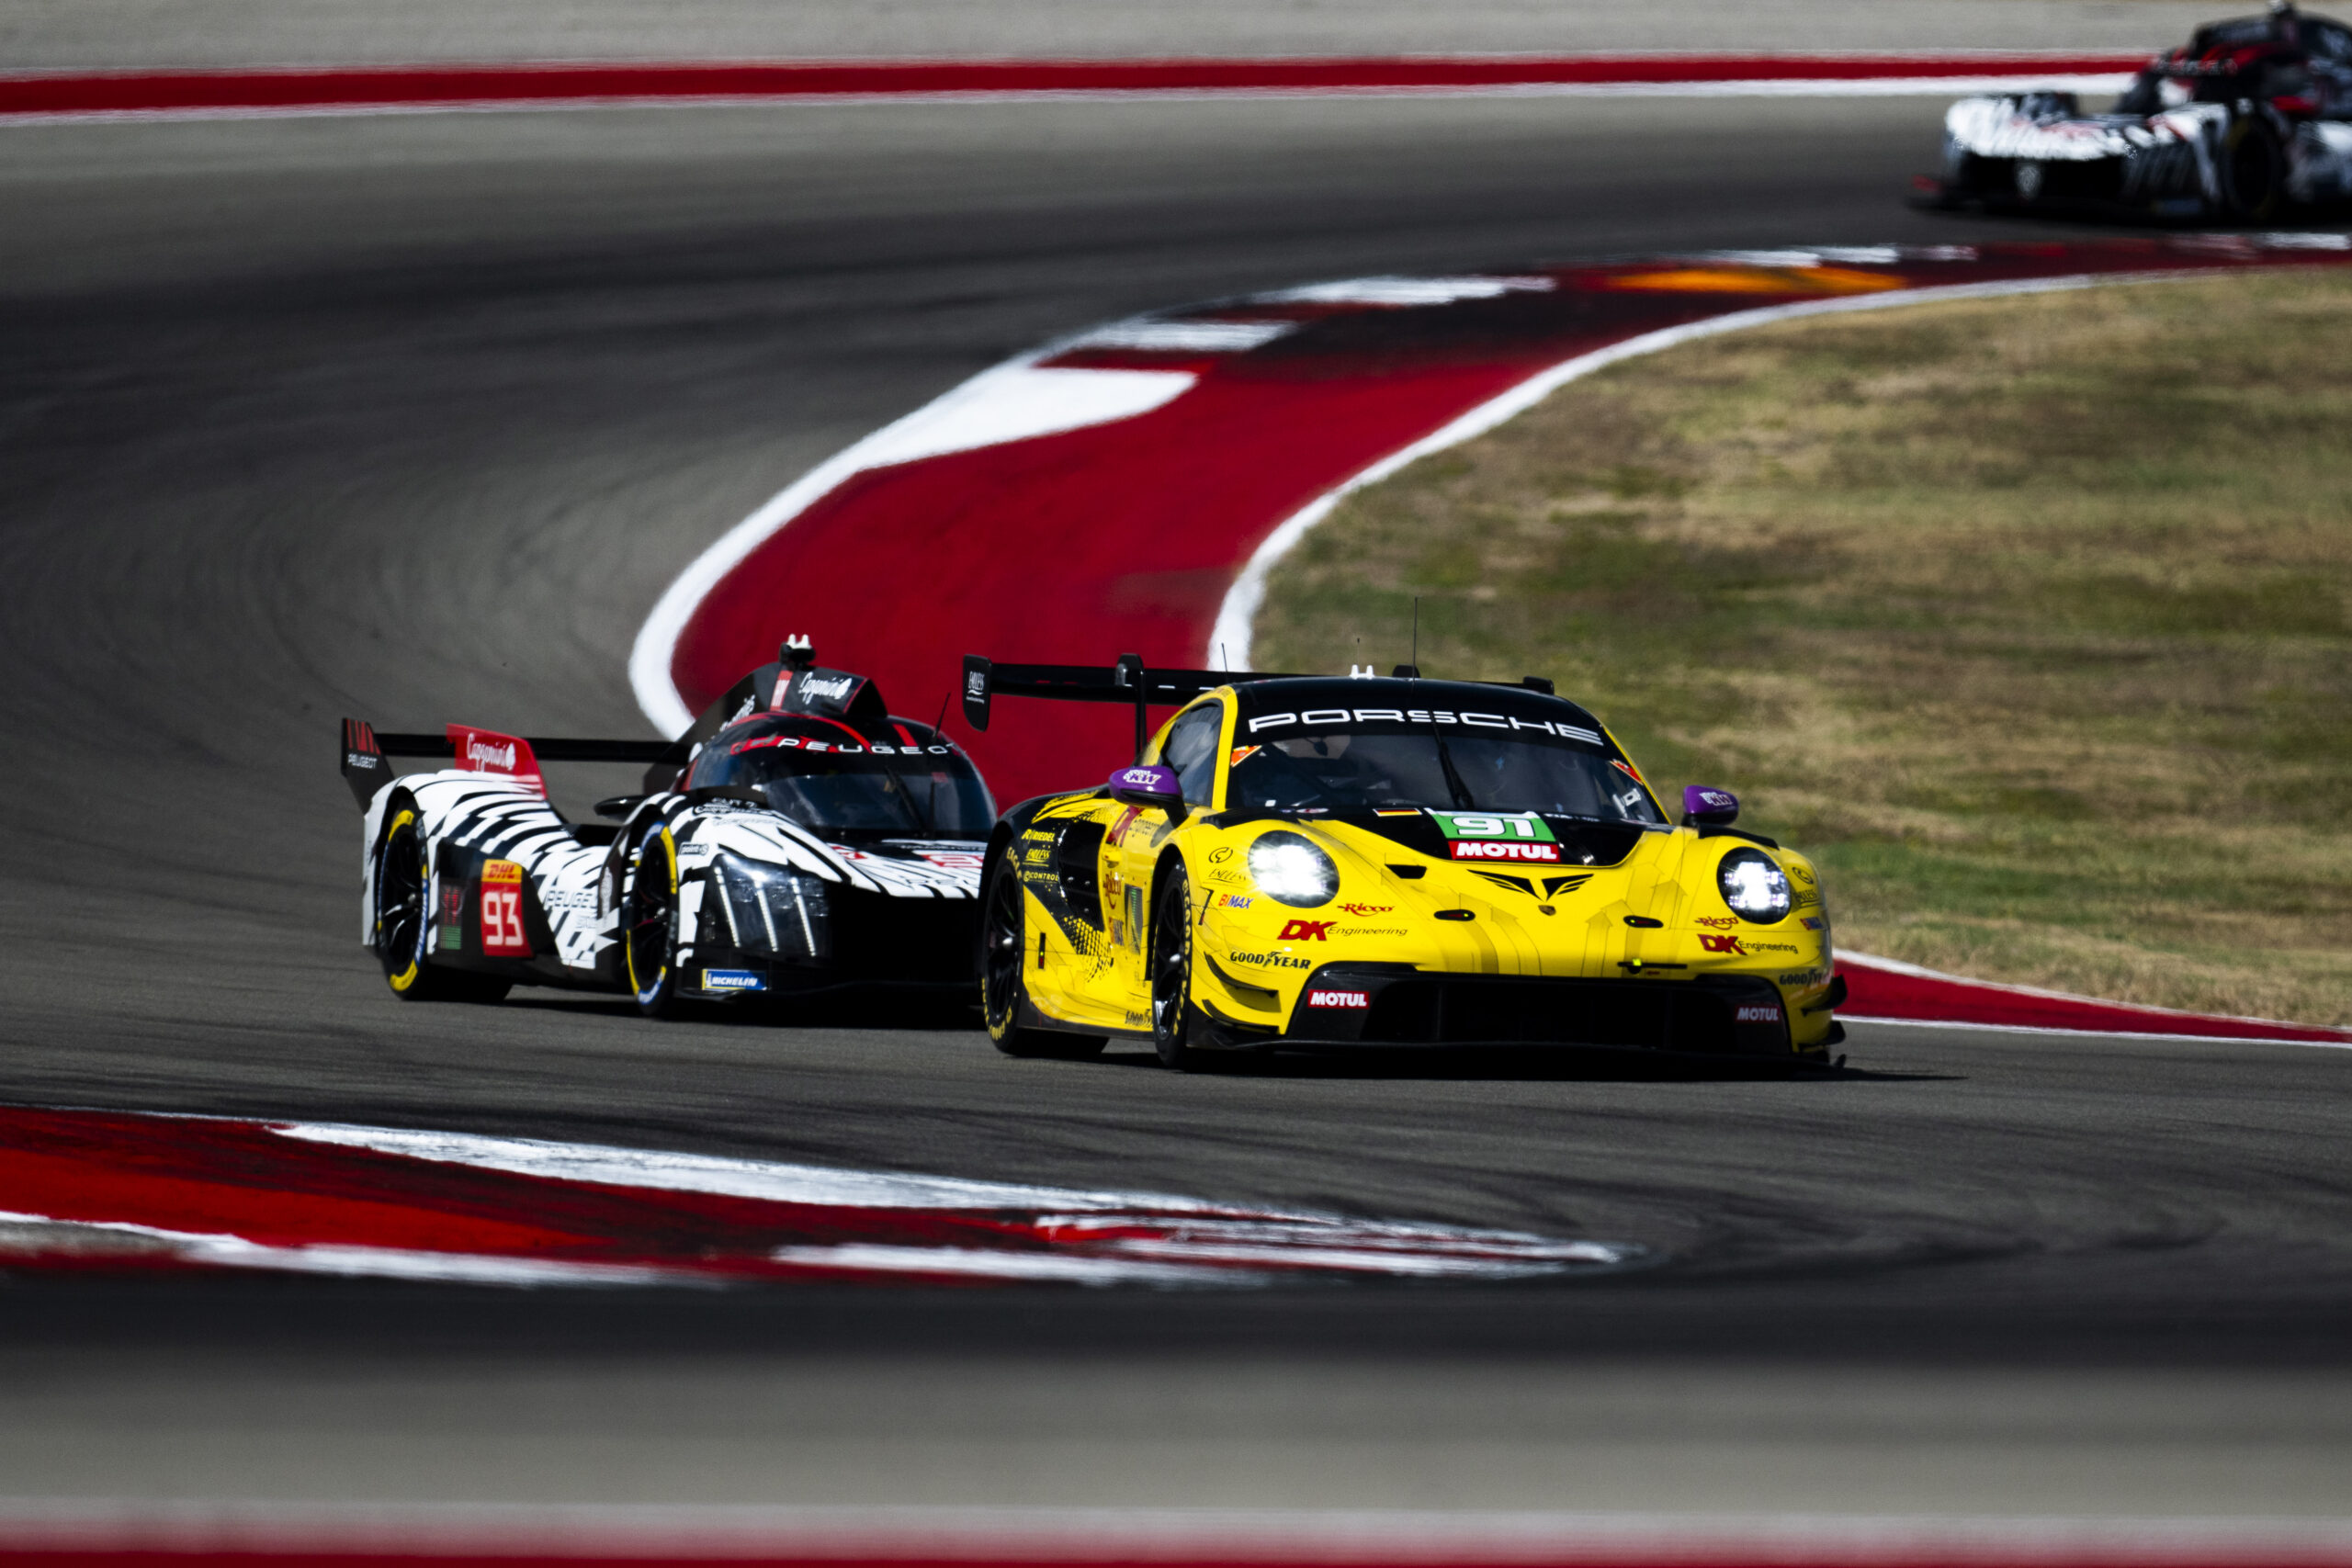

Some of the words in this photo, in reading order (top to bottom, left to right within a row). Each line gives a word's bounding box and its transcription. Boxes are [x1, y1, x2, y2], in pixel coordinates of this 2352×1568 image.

[1249, 709, 1604, 747] PORSCHE
[1453, 817, 1536, 838] 91
[1456, 842, 1557, 860] MOTUL
[488, 864, 515, 878] DHL
[483, 891, 524, 946] 93
[1277, 919, 1339, 942] DK
[1328, 926, 1408, 937] Engineering
[1697, 933, 1748, 956] DK
[1738, 941, 1799, 954] Engineering
[1230, 951, 1312, 969] GOODYEAR
[712, 976, 758, 987] MICHELIN
[1779, 968, 1822, 987] GOODY
[1310, 992, 1367, 1007] MOTUL
[1737, 1007, 1780, 1021] MOTUL
